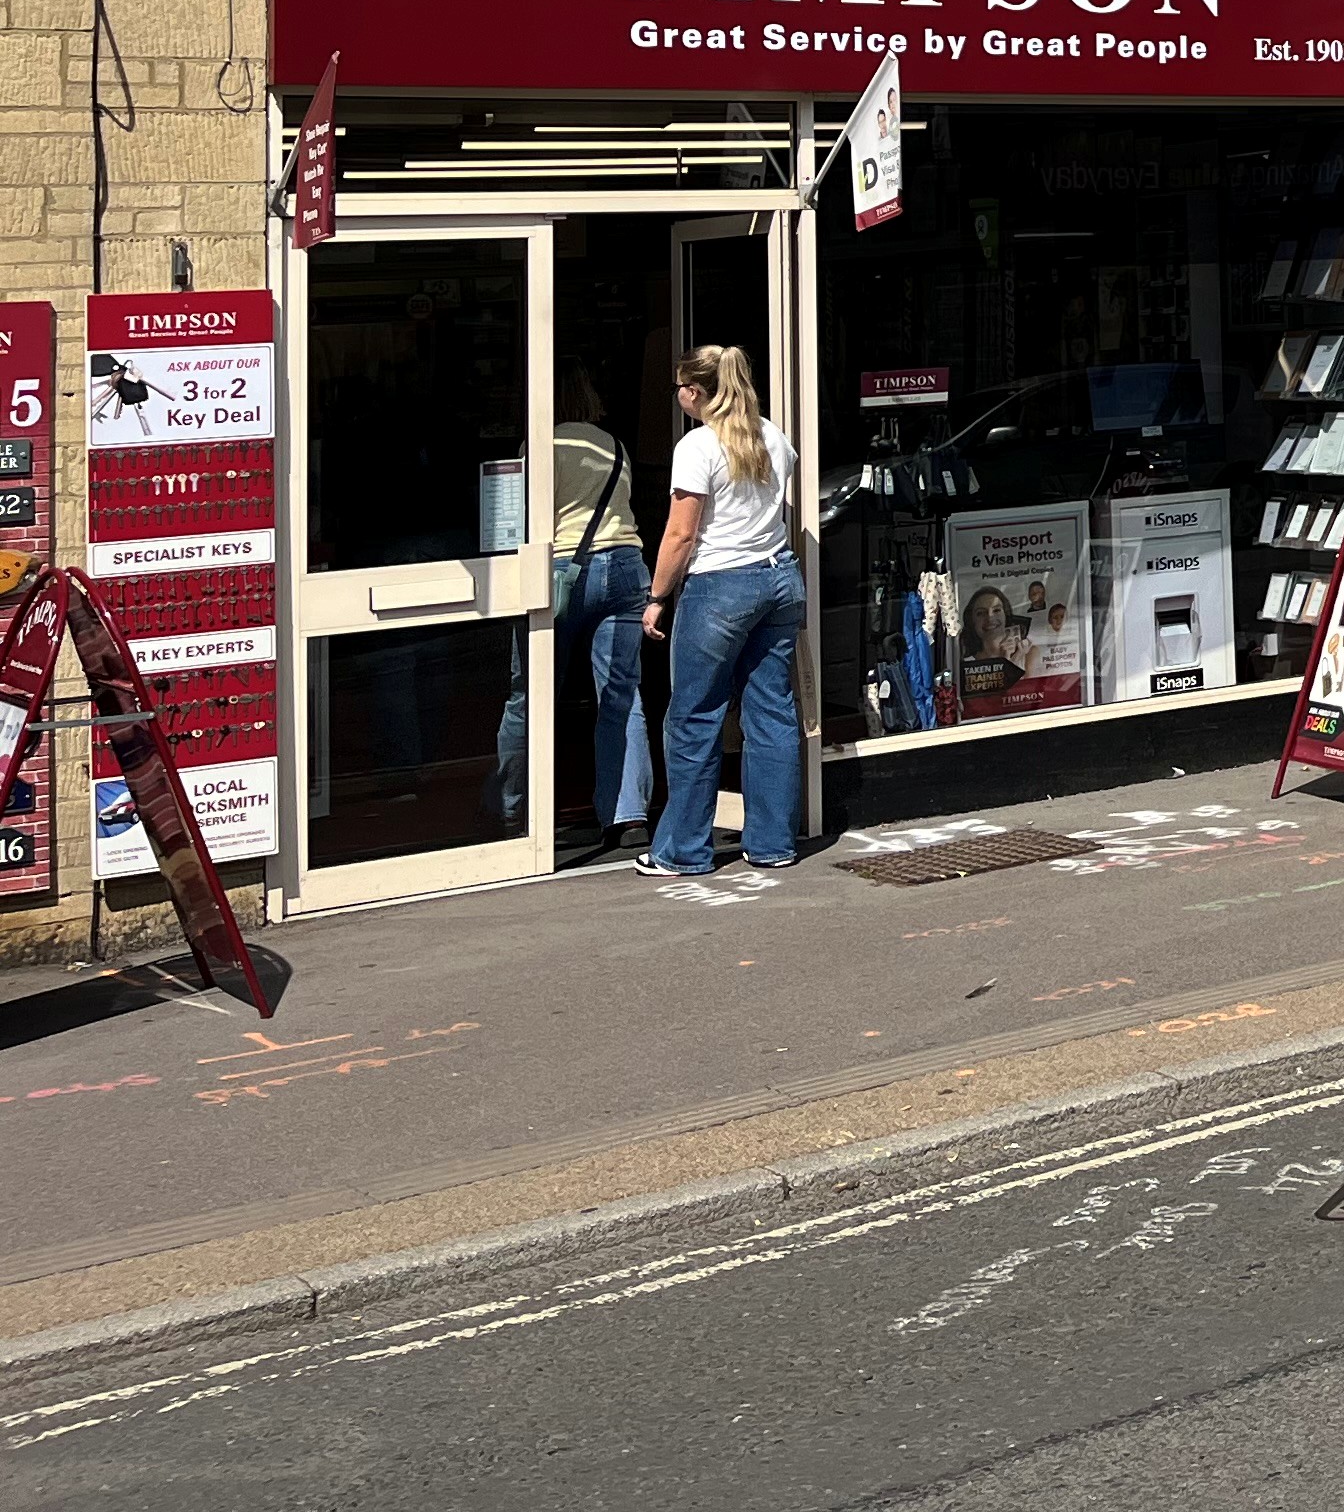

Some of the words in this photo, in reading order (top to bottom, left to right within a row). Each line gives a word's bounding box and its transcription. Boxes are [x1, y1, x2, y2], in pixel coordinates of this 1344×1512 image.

[630, 20, 746, 49] Great
[763, 24, 908, 52] Service
[924, 28, 966, 60] by
[983, 30, 1081, 56] Great
[1096, 33, 1207, 63] People
[1254, 38, 1299, 61] Est.
[124, 312, 237, 330] TIMPSON
[167, 361, 190, 372] ASK
[193, 360, 233, 371] ABOUT
[236, 358, 261, 368] OUR
[183, 380, 199, 402] 3
[203, 387, 227, 399] for
[230, 378, 246, 399] 2
[873, 375, 937, 389] TIMPSON
[167, 408, 206, 429] Key
[214, 406, 261, 424] Deal
[1154, 512, 1199, 527] iSnaps
[982, 530, 1053, 551] Passport
[113, 545, 205, 565] SPECIALIST
[212, 541, 252, 557] KEYS
[972, 555, 981, 568] &
[985, 553, 1014, 567] Visa
[1018, 549, 1063, 563] Photos
[1155, 556, 1200, 571] iSnaps
[151, 647, 181, 661] KEY
[186, 639, 254, 657] EXPERTS
[964, 665, 992, 675] TAKEN
[1156, 675, 1197, 692] iSnaps
[1002, 692, 1045, 704] TIMPSON
[1304, 715, 1337, 735] DEALS
[194, 779, 247, 797] LOCAL
[194, 793, 269, 815] CKSMITH
[199, 812, 247, 828] SERVICE
